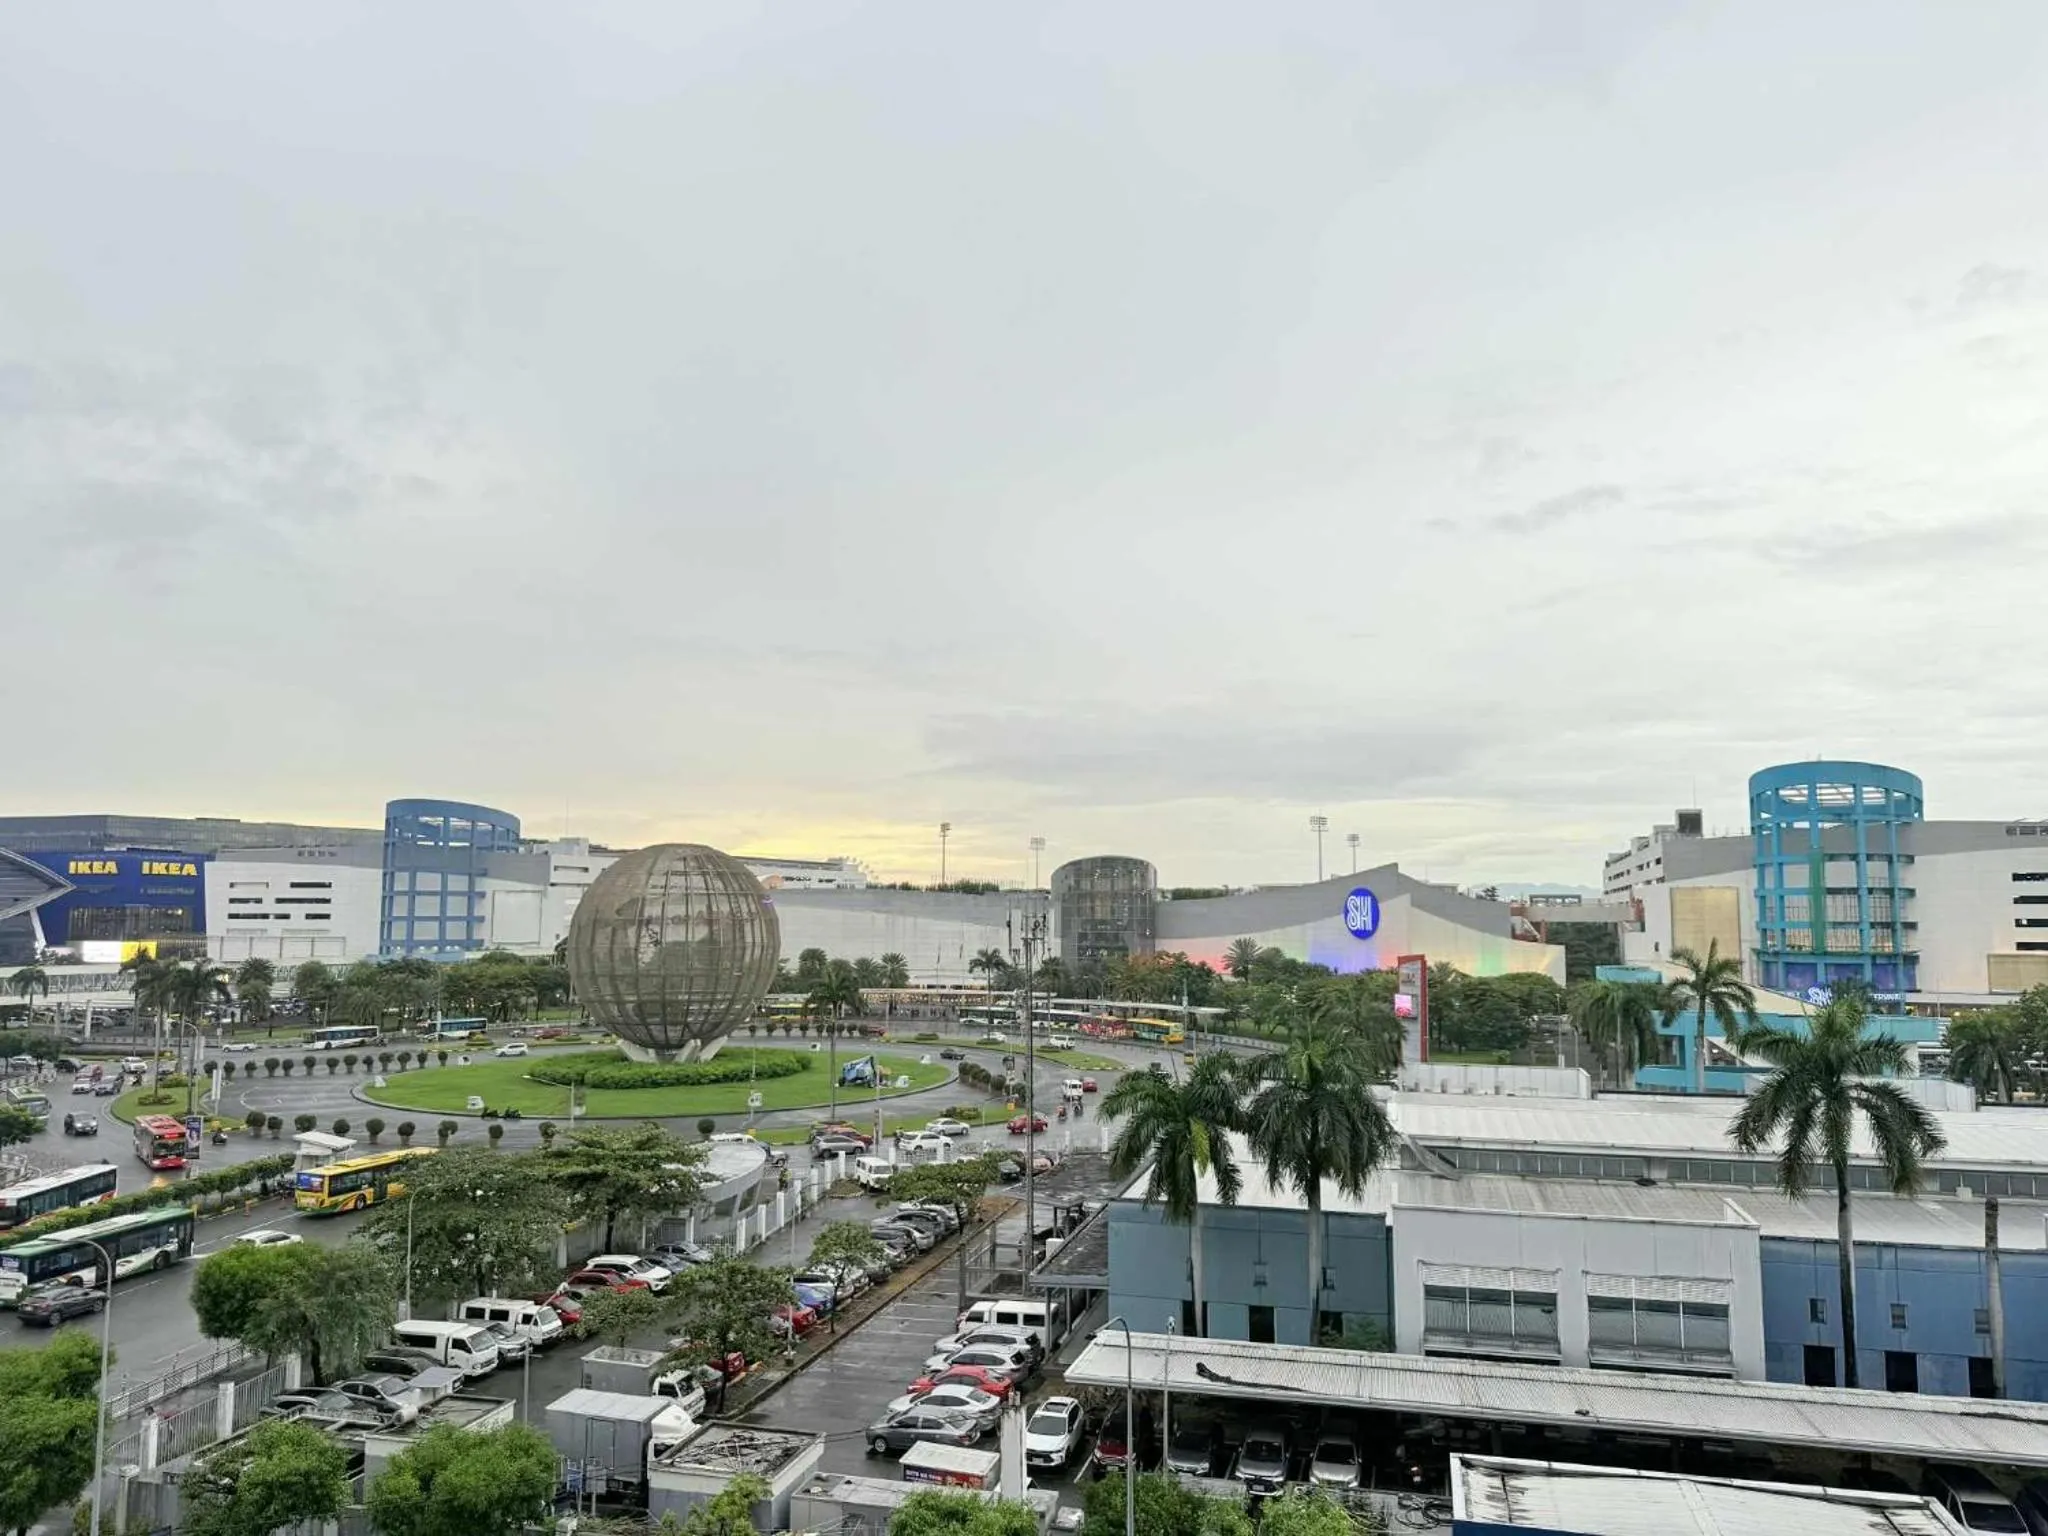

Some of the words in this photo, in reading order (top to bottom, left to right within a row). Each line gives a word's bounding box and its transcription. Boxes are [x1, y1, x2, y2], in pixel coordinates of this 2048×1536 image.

[68, 861, 118, 874] IKEA
[142, 861, 197, 876] IKEA
[1347, 895, 1372, 931] SM
